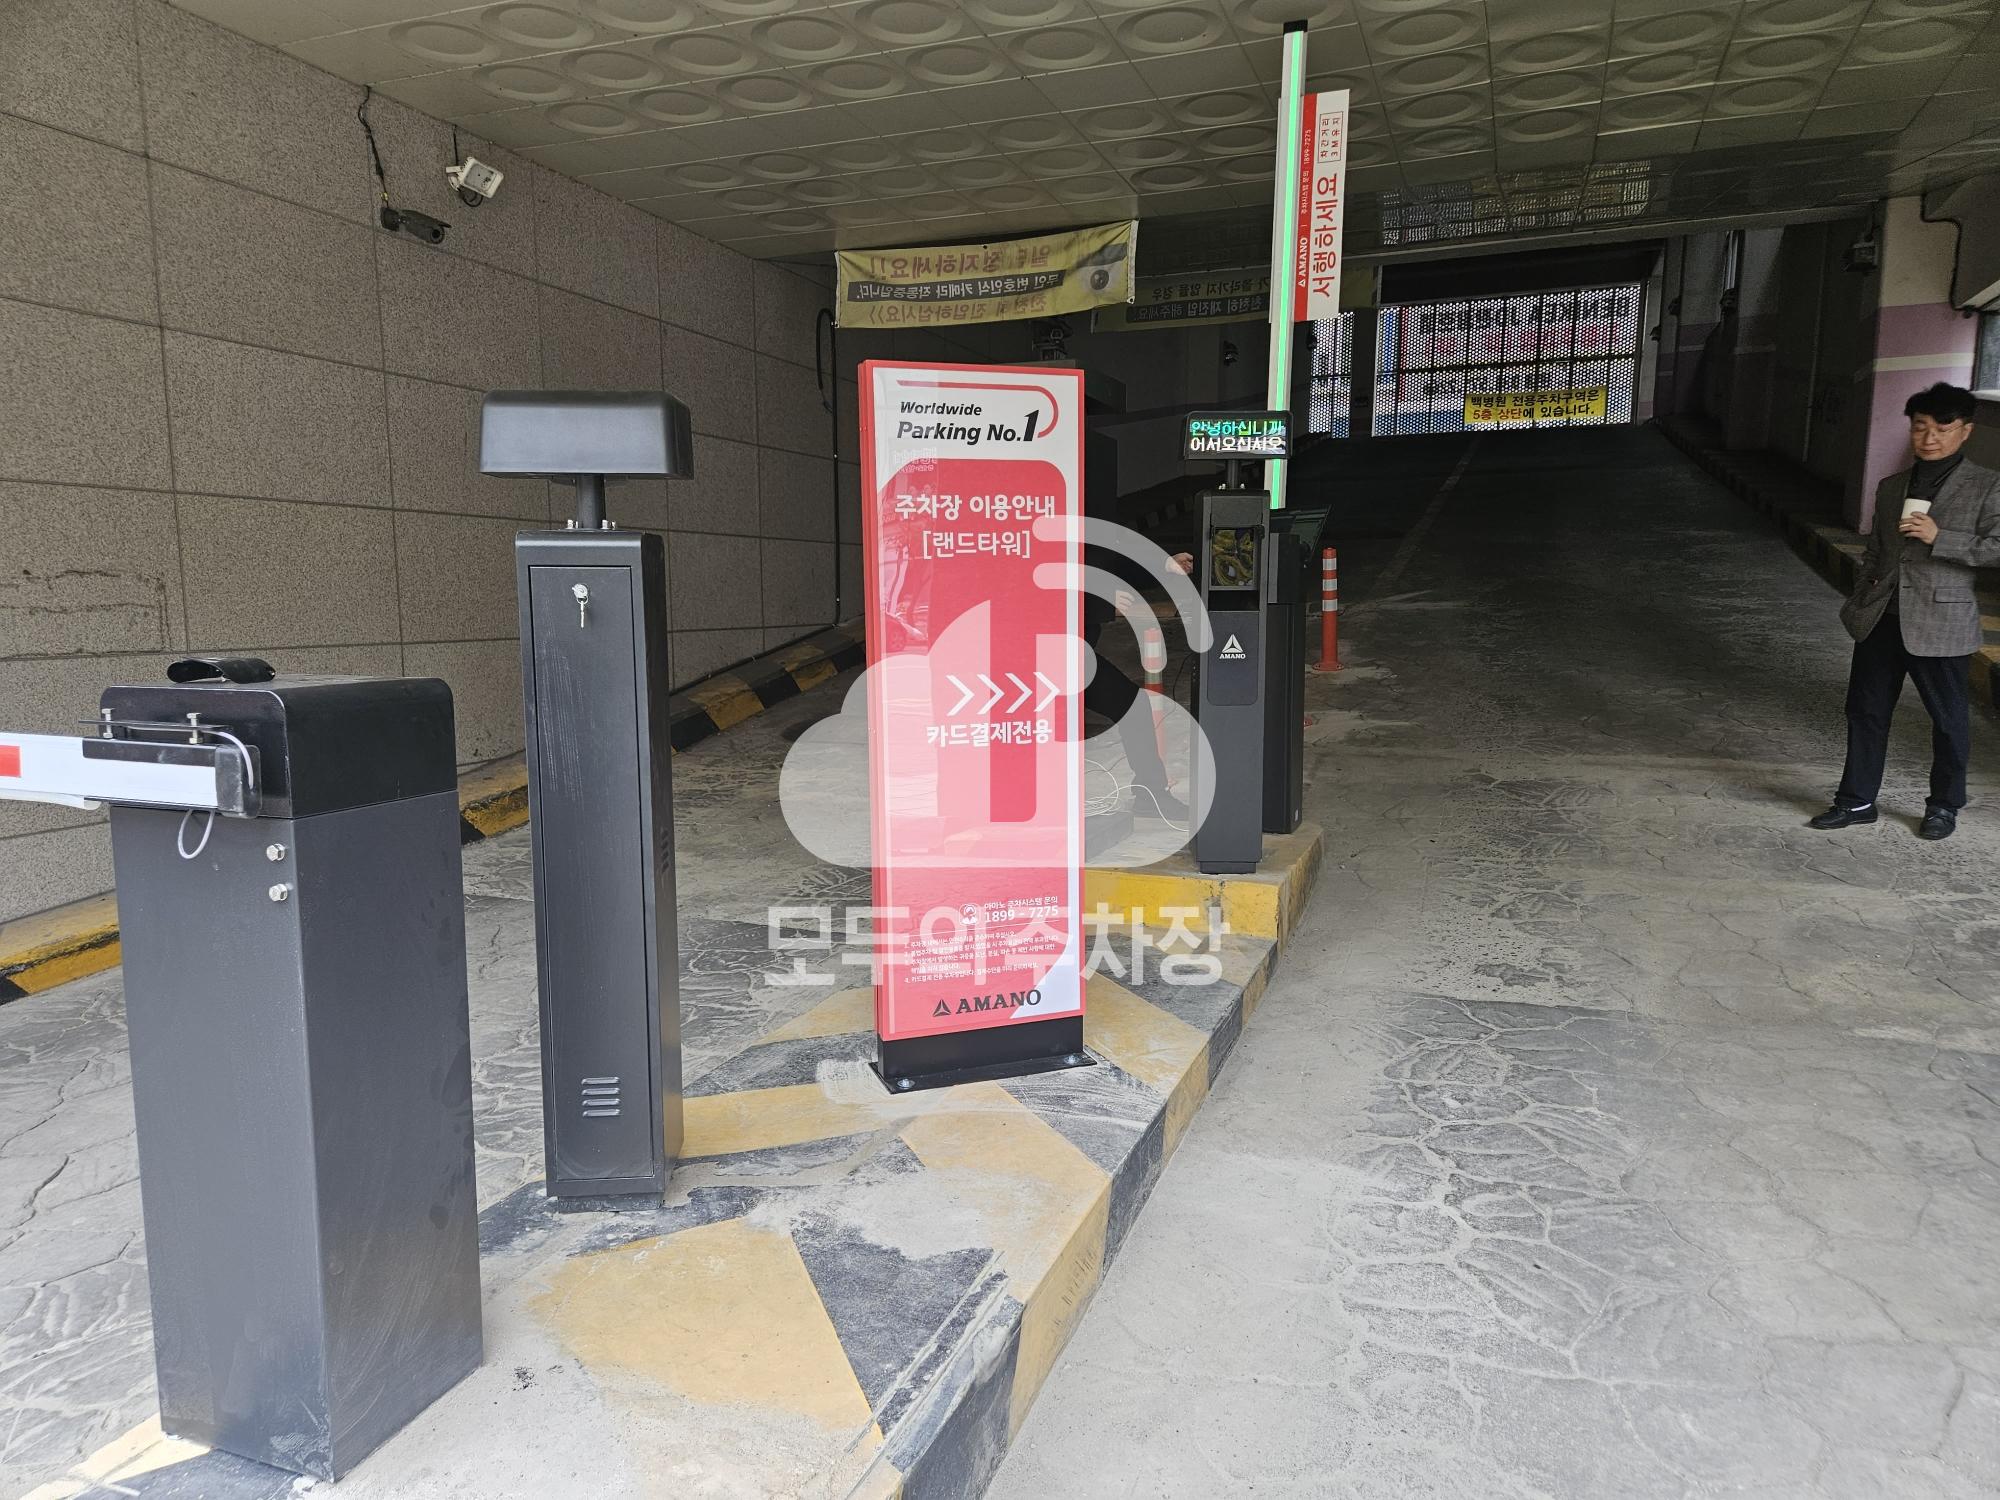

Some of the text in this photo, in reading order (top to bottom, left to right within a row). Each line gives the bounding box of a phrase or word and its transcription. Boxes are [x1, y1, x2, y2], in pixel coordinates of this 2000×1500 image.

[1312, 173, 1338, 298] 서행하세요
[1298, 237, 1309, 278] AMANO
[900, 401, 982, 416] Worldwide
[1471, 389, 1600, 408] 백병원 전용주차구역은
[1473, 403, 1595, 420] 5층 상단에 있습니다.
[896, 409, 1040, 446] Parking No.1
[1190, 420, 1284, 436] 안녕하십니까
[1190, 436, 1284, 452] 어서오십시오
[894, 494, 1056, 521] 주차장 이용안내
[922, 530, 1031, 560] [랜드타워]
[926, 719, 1053, 748] 카드결제전용
[983, 901, 1006, 911] 아마노
[984, 909, 1015, 923] 1899
[1028, 905, 1059, 918] 7275
[955, 989, 1042, 1014] AMANO
